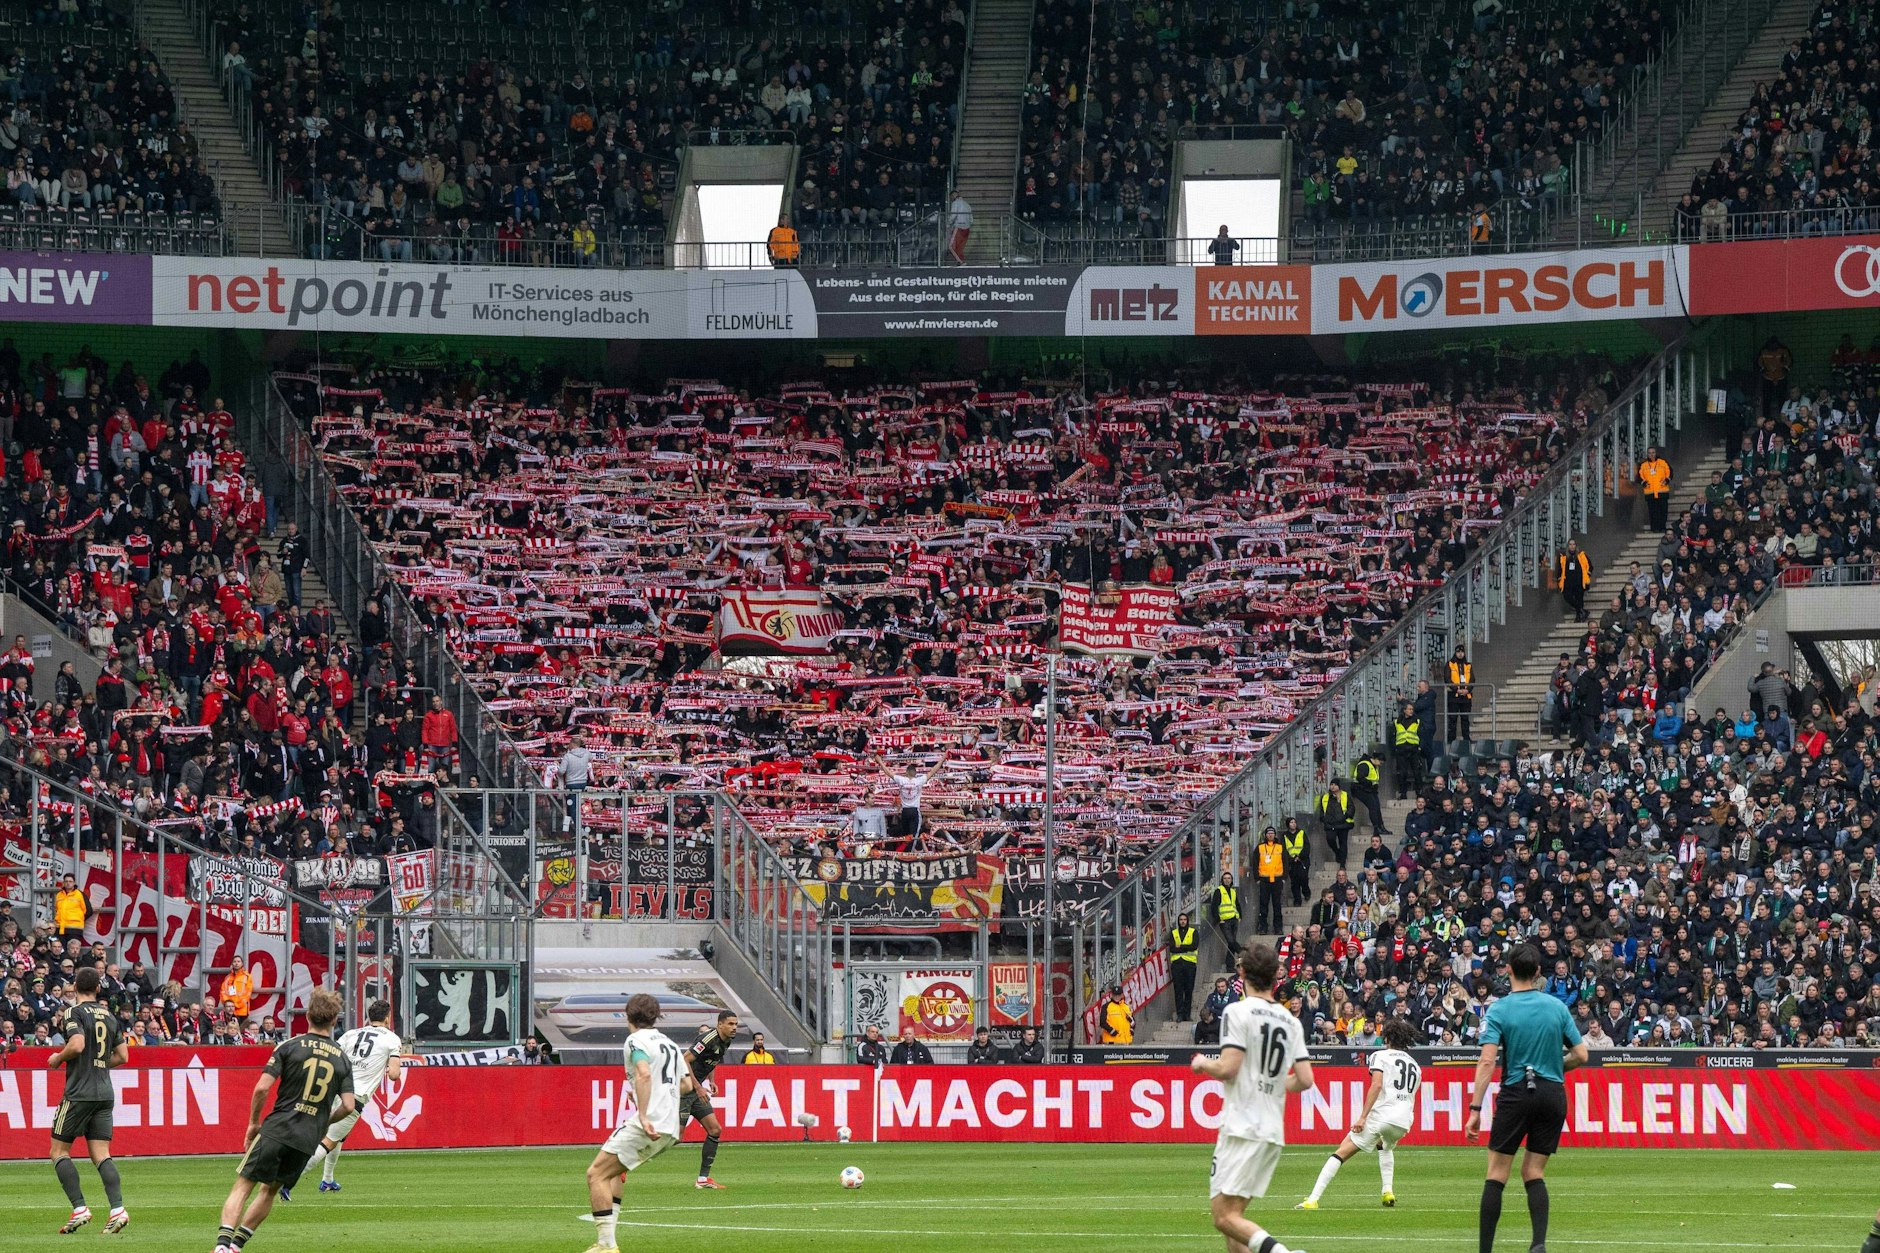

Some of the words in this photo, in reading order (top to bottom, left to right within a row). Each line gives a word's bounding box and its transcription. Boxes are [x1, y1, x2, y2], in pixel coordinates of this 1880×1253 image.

[816, 277, 864, 288] Lebens-
[867, 277, 890, 287] und
[894, 276, 1021, 290] Gestaltungs(t)räume
[1024, 276, 1067, 286] mieten
[1208, 281, 1298, 300] KANAL
[187, 266, 452, 326] netpoint
[488, 283, 593, 302] IT-Services
[600, 288, 633, 301] aus
[849, 292, 872, 302] Aus
[874, 291, 896, 302] der
[899, 291, 945, 304] Region,
[948, 291, 968, 302] für
[970, 291, 989, 301] die
[991, 291, 1033, 304] Region
[1091, 284, 1178, 321] metz
[472, 304, 649, 325] Mönchengladbach
[706, 313, 793, 330] FELDMÜHLE
[1208, 305, 1298, 322] TECHNIK
[885, 319, 998, 330] www.fmviersen.de
[1155, 531, 1210, 542] UNION
[918, 553, 948, 564] UNIONER
[1062, 589, 1089, 603] Von
[1130, 593, 1179, 607] Wiege
[1063, 602, 1085, 615] bis
[1091, 607, 1116, 618] zur
[1127, 608, 1175, 621] Bahre
[795, 612, 844, 638] UNION
[1063, 617, 1109, 631] bleiben
[1115, 622, 1137, 632] wir
[1063, 629, 1080, 640] FC
[1084, 632, 1124, 645] UNION
[488, 837, 526, 846] UNIONER
[845, 856, 968, 881] DIFFIDATI
[213, 876, 265, 899] Brigde
[534, 966, 698, 976] amechanger.
[308, 1040, 318, 1049] FC
[319, 1042, 341, 1057] UNION
[352, 1031, 378, 1058] 15
[1260, 1022, 1287, 1078] 16
[1104, 1053, 1123, 1061] making
[1707, 1056, 1753, 1067] KYOCERA
[303, 1057, 335, 1103] 13
[1394, 1058, 1418, 1094] 36
[0, 1068, 219, 1129] ALEIN
[879, 1079, 1113, 1129] MACHT
[1130, 1079, 1224, 1129] SIC
